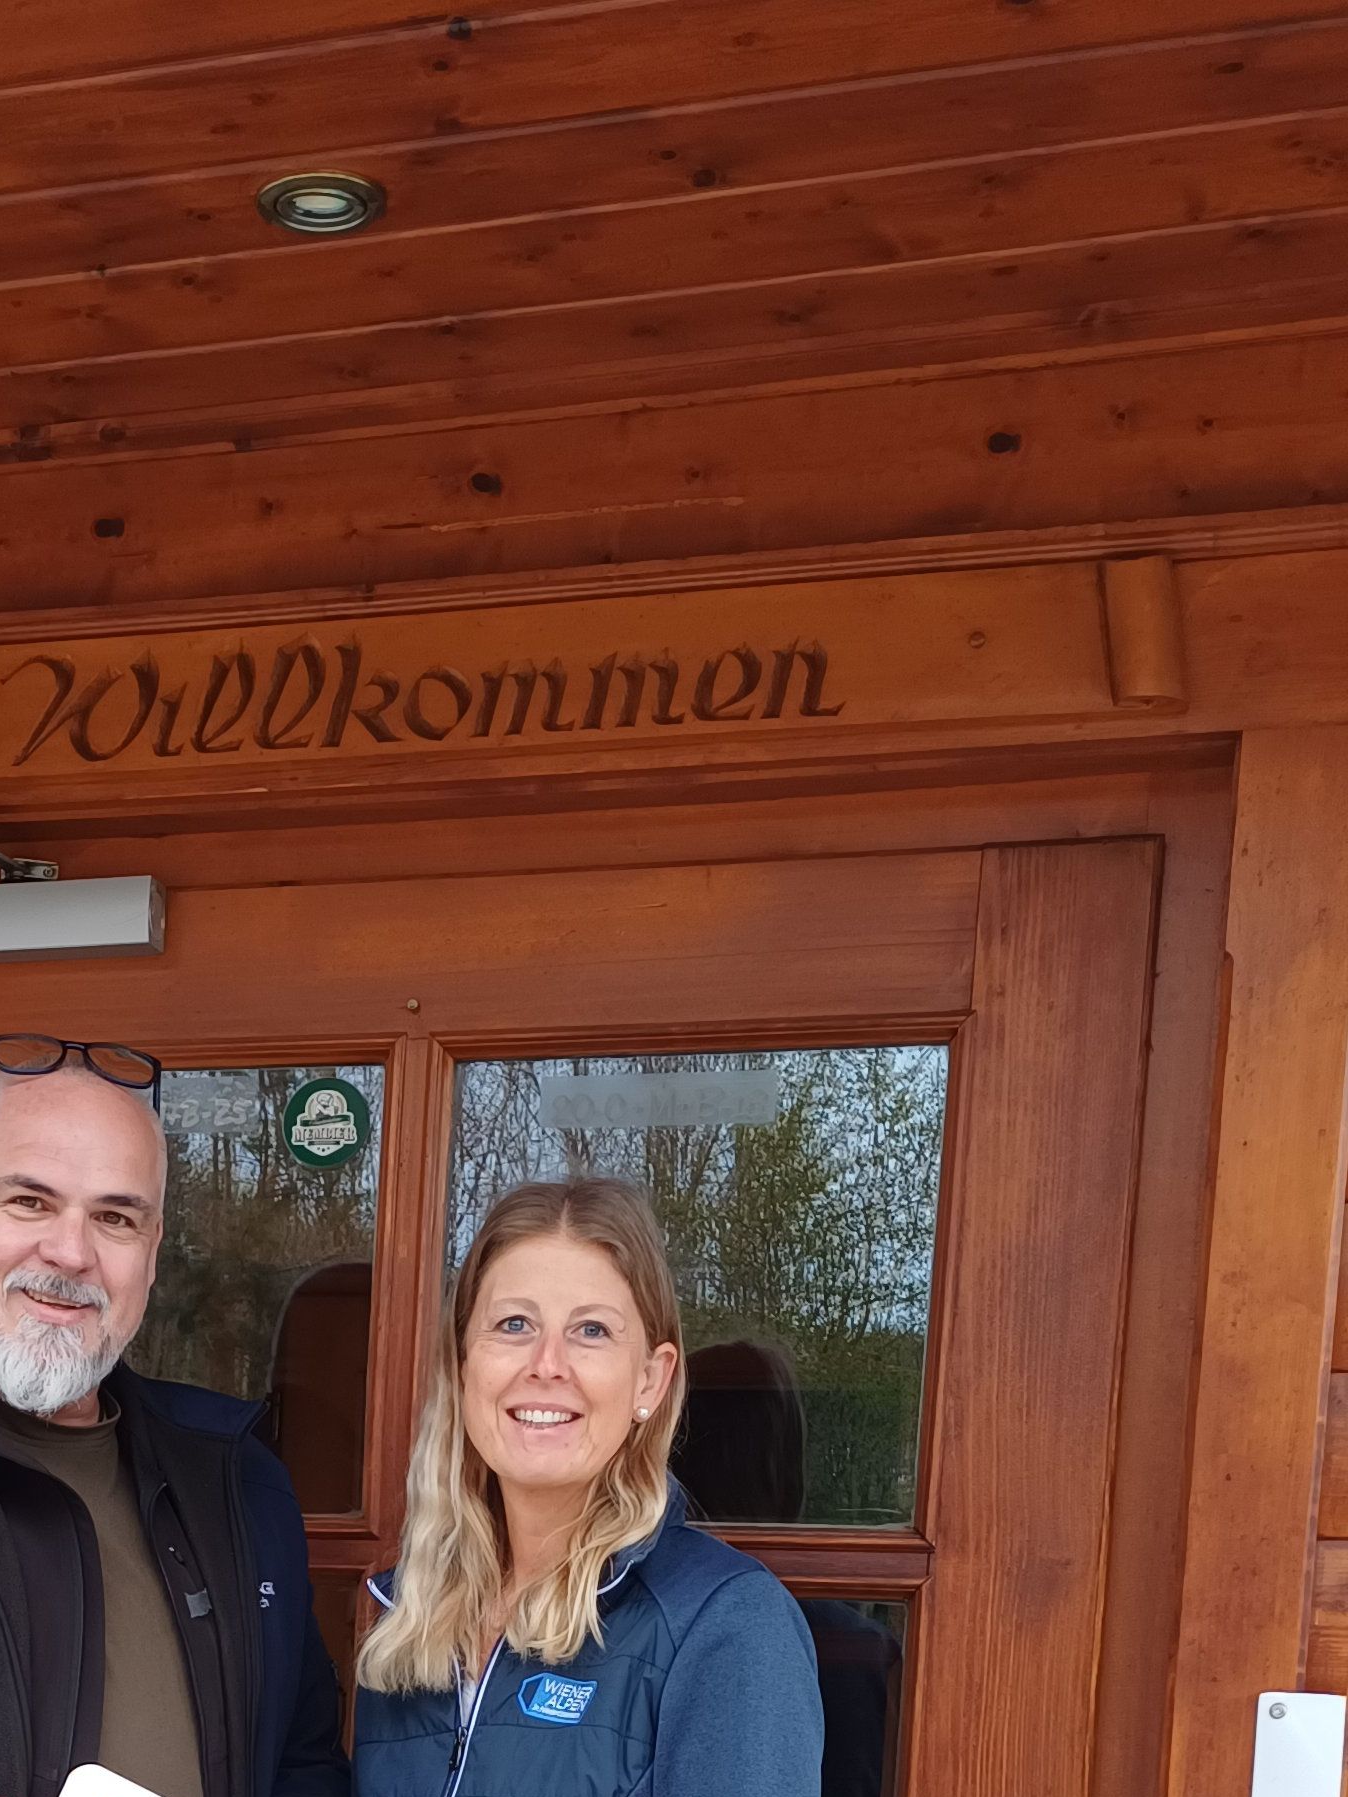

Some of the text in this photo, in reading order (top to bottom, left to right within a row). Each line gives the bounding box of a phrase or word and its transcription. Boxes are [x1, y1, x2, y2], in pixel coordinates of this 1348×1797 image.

[0, 631, 846, 766] Willkommen
[545, 1678, 594, 1700] WIENER
[545, 1695, 589, 1712] ALPEN
